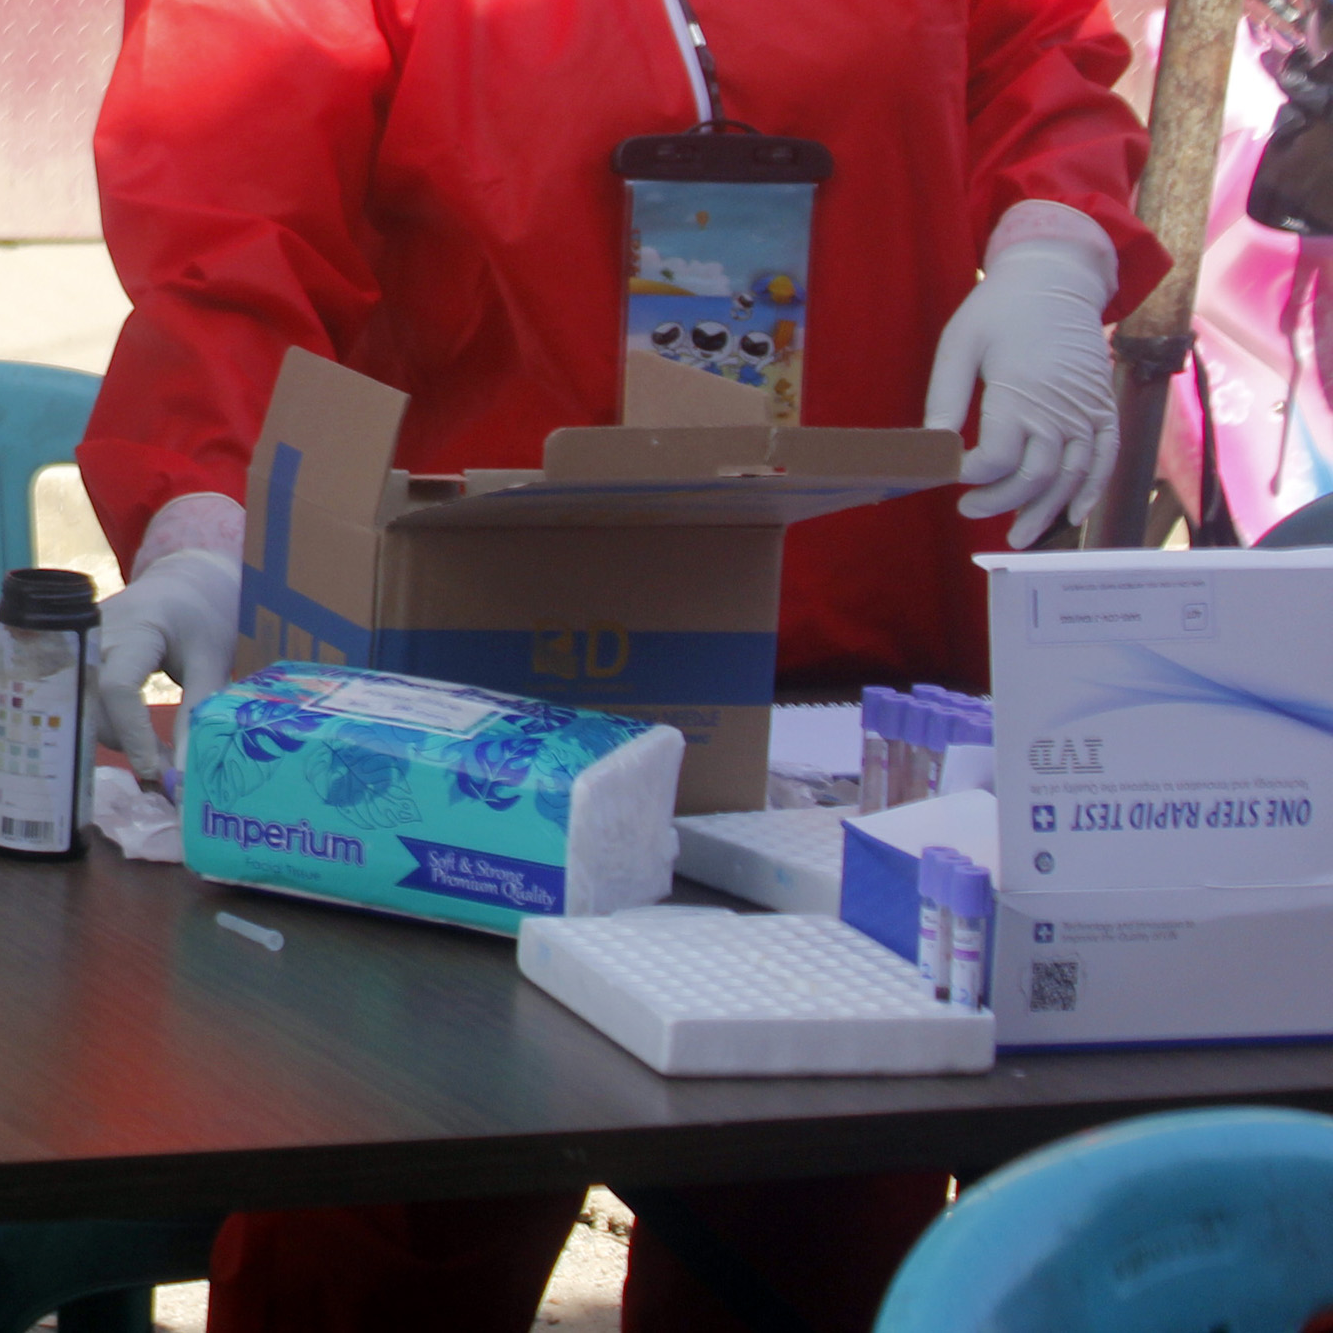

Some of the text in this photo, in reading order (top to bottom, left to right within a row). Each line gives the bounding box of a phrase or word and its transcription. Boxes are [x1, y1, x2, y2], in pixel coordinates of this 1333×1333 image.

[1028, 738, 1104, 775] IVD
[1070, 798, 1312, 832] ONE STEP RAPID TEST
[200, 800, 366, 868] Imperium
[427, 850, 525, 885] Soft & Strong
[432, 869, 557, 912] Premium Quality
